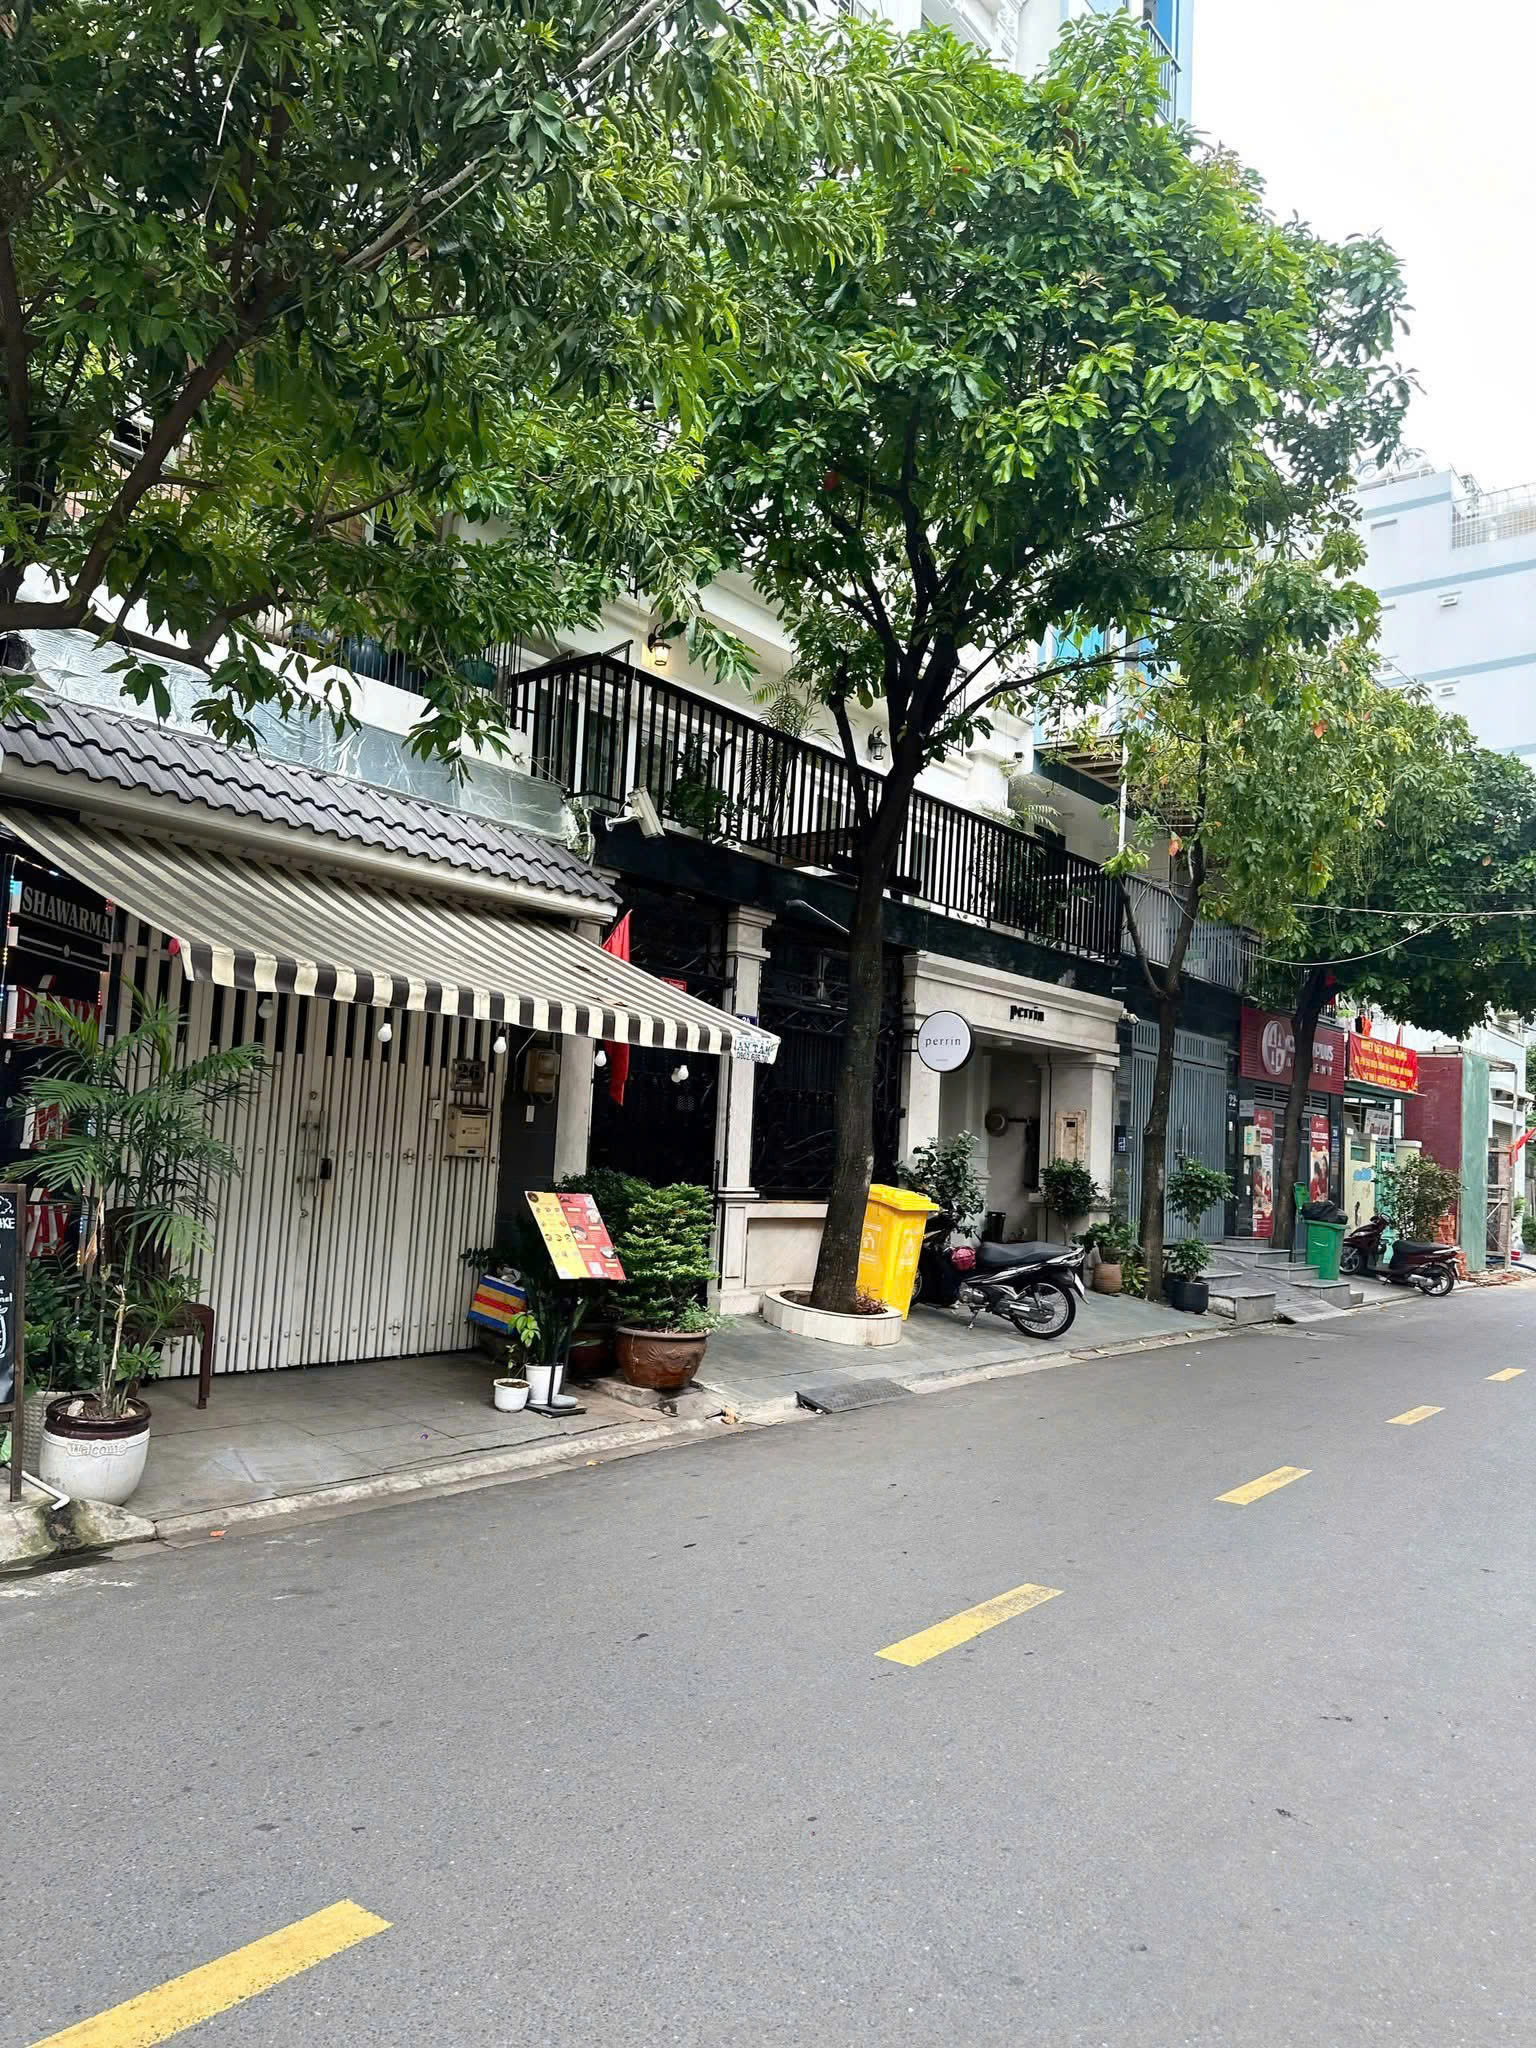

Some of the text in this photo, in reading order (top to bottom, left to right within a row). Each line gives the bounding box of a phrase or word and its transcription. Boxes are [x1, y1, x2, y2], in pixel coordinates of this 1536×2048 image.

[22, 886, 110, 939] SHAWARMA
[1010, 1005, 1045, 1022] perrin
[925, 1037, 961, 1047] perrin
[70, 1443, 126, 1456] Welcome
